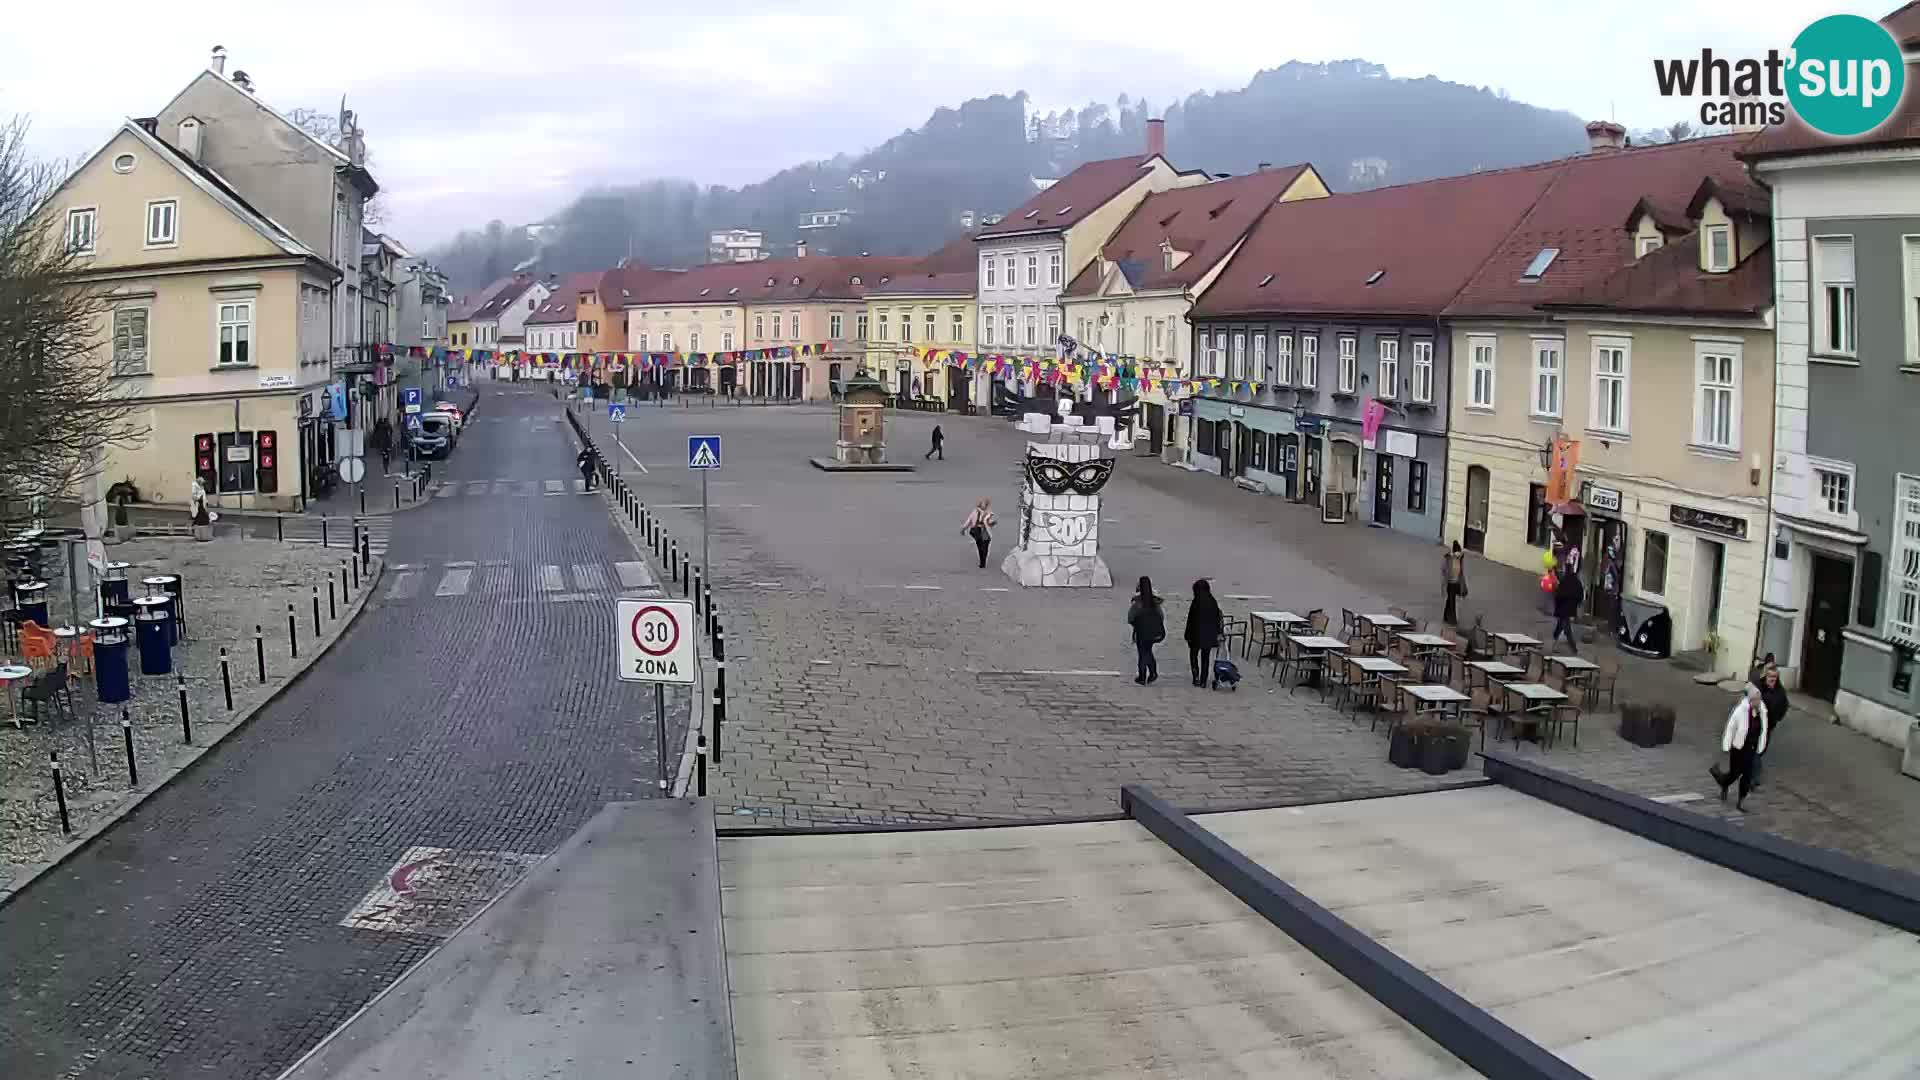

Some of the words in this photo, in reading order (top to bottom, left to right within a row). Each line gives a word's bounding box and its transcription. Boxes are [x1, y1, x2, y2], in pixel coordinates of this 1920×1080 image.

[409, 391, 417, 402] P
[1047, 516, 1087, 545] 200
[644, 621, 668, 642] 30
[635, 659, 678, 675] ZONA
